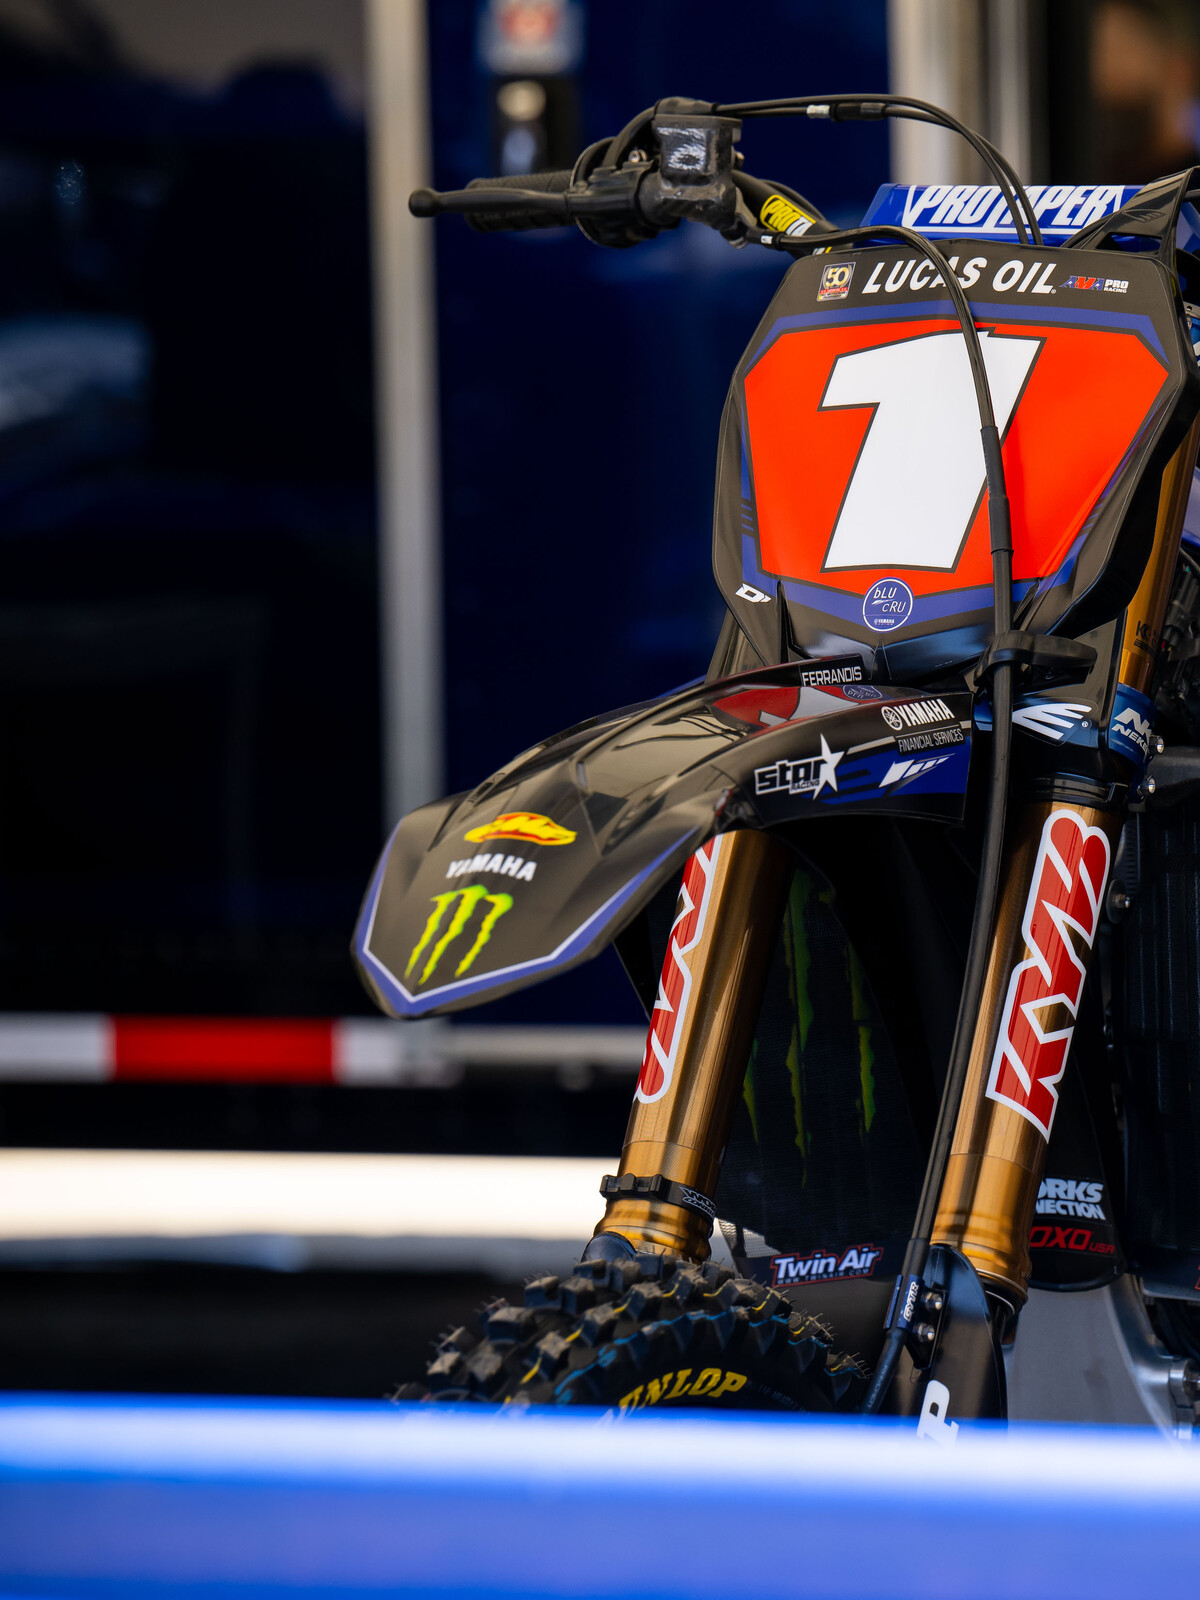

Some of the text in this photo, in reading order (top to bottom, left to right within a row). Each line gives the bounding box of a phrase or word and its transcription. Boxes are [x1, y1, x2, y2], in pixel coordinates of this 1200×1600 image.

[824, 266, 850, 288] 50
[861, 256, 988, 295] LUCAS
[991, 259, 1057, 295] OIL
[1059, 275, 1130, 291] AMA PRO
[819, 328, 1048, 574] 1
[801, 666, 862, 687] FERRANDIS
[896, 698, 955, 728] YAMAHA
[898, 727, 965, 753] FINANCIAL SERVICES
[445, 853, 537, 882] YAMAHA
[985, 808, 1111, 1145] KYB
[1088, 1242, 1115, 1254] USA
[774, 1247, 877, 1279] Twin Air
